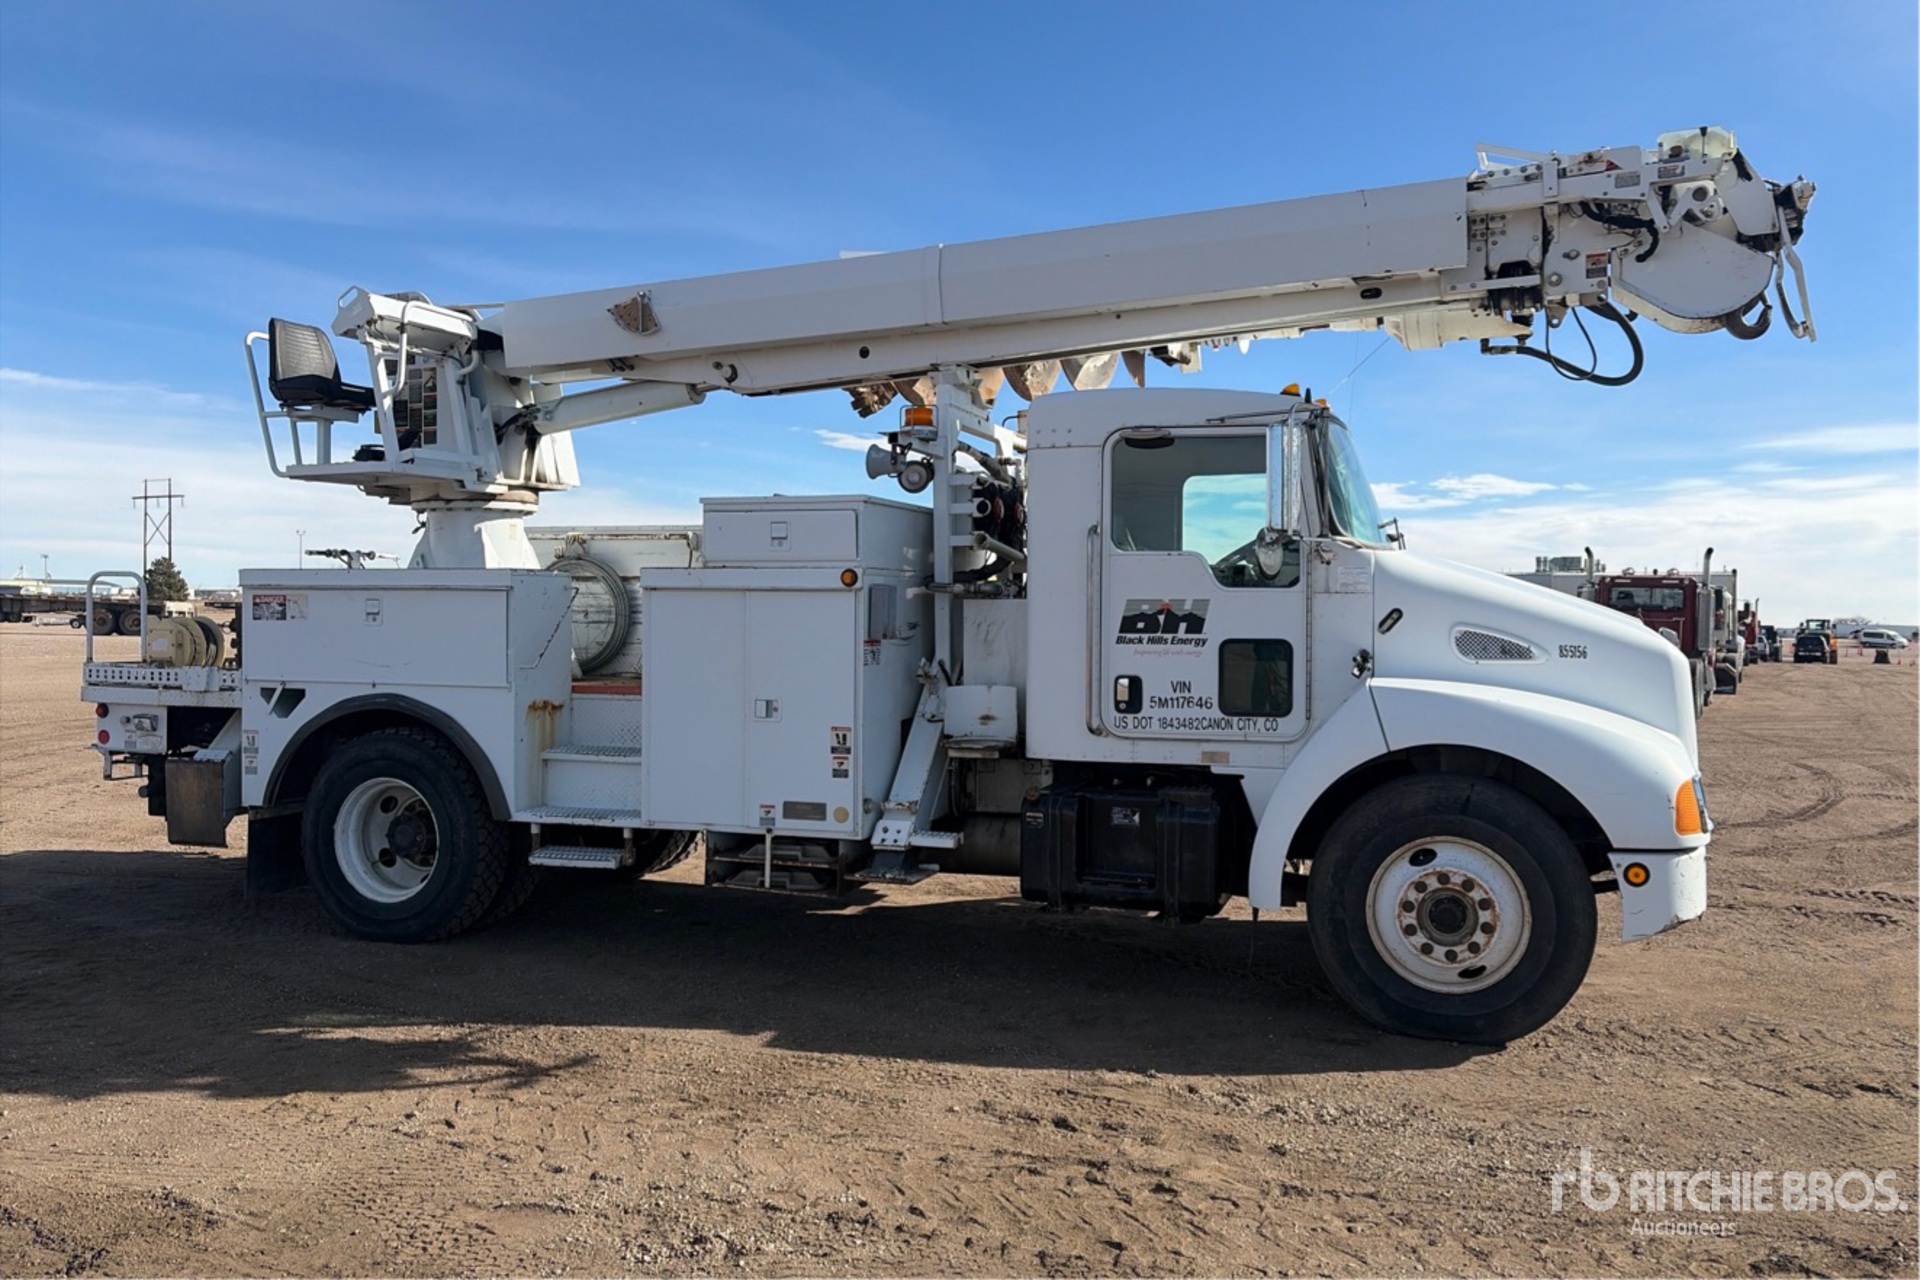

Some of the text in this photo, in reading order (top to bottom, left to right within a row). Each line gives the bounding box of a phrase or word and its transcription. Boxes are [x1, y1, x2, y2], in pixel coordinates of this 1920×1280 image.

[1116, 635, 1208, 648] Black Hills Energy
[1558, 644, 1588, 660] 855156
[1170, 680, 1192, 694] VIN
[1149, 696, 1214, 710] 5M117646
[1114, 715, 1201, 731] US DOT 1843482
[1201, 716, 1279, 734] CANON CITY, CO
